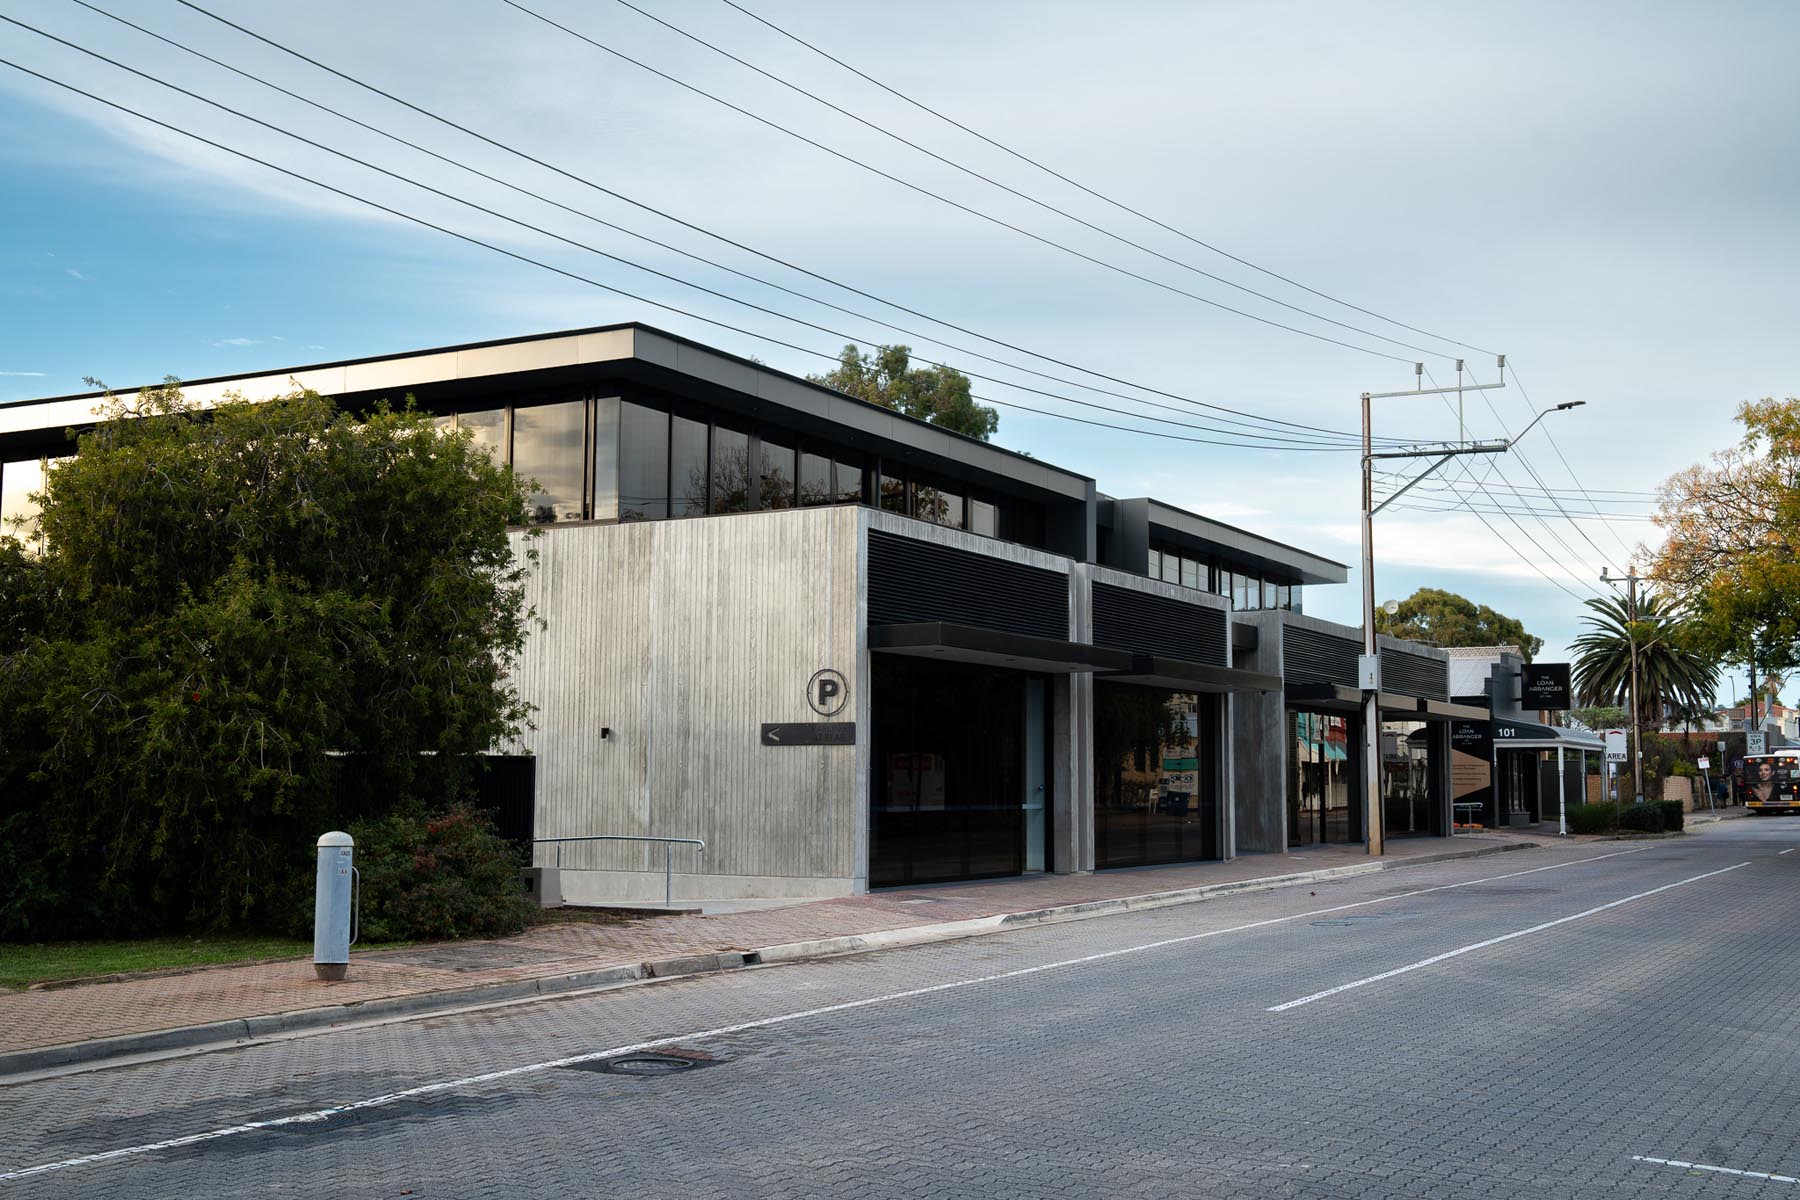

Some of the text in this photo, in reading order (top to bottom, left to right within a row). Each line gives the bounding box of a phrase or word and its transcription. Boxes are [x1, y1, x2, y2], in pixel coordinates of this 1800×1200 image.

[819, 679, 838, 705] P
[1498, 728, 1515, 737] 101
[1750, 738, 1762, 746] 3P
